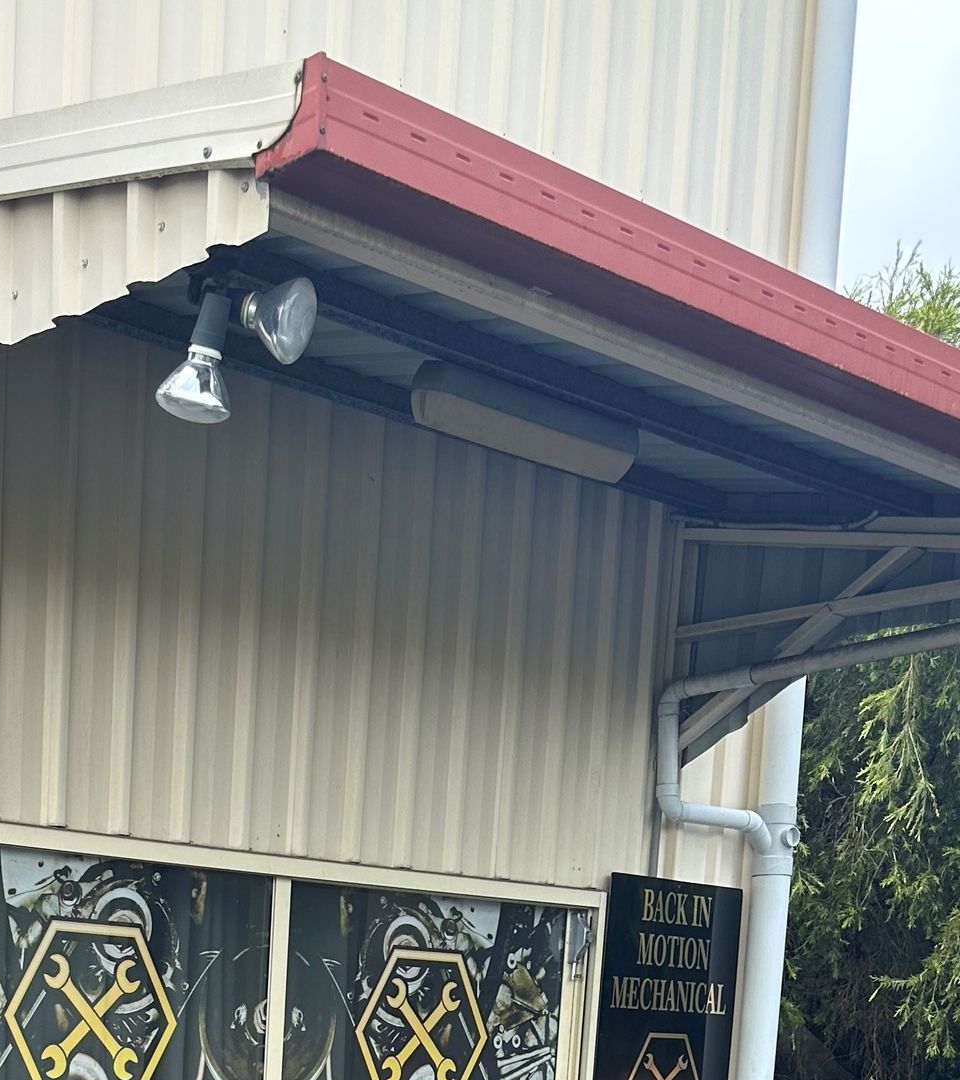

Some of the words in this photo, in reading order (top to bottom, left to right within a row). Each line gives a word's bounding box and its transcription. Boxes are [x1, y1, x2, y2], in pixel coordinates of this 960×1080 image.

[642, 888, 688, 926] BACK
[692, 896, 713, 928] IN
[637, 932, 711, 971] MOTION
[611, 976, 726, 1015] MECHANICAL
